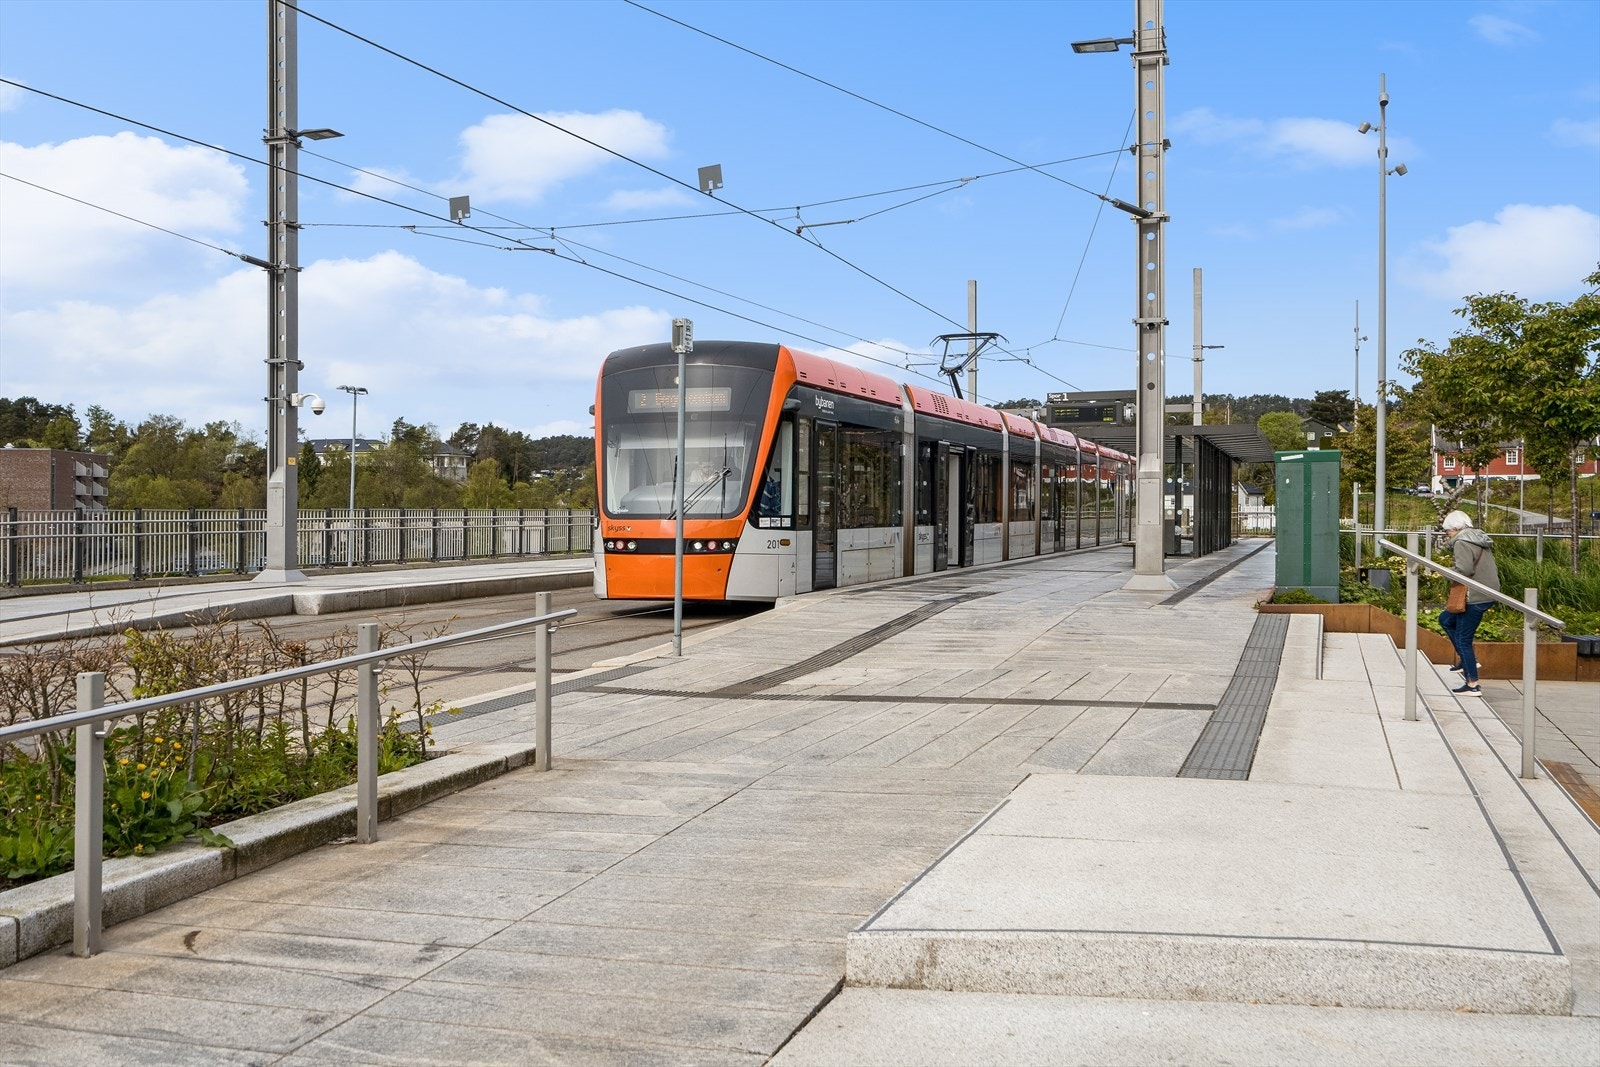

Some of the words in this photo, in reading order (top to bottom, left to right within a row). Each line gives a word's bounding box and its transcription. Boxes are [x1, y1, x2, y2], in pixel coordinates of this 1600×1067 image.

[1062, 392, 1069, 401] 1
[607, 523, 626, 533] skyss
[767, 539, 780, 549] 201
